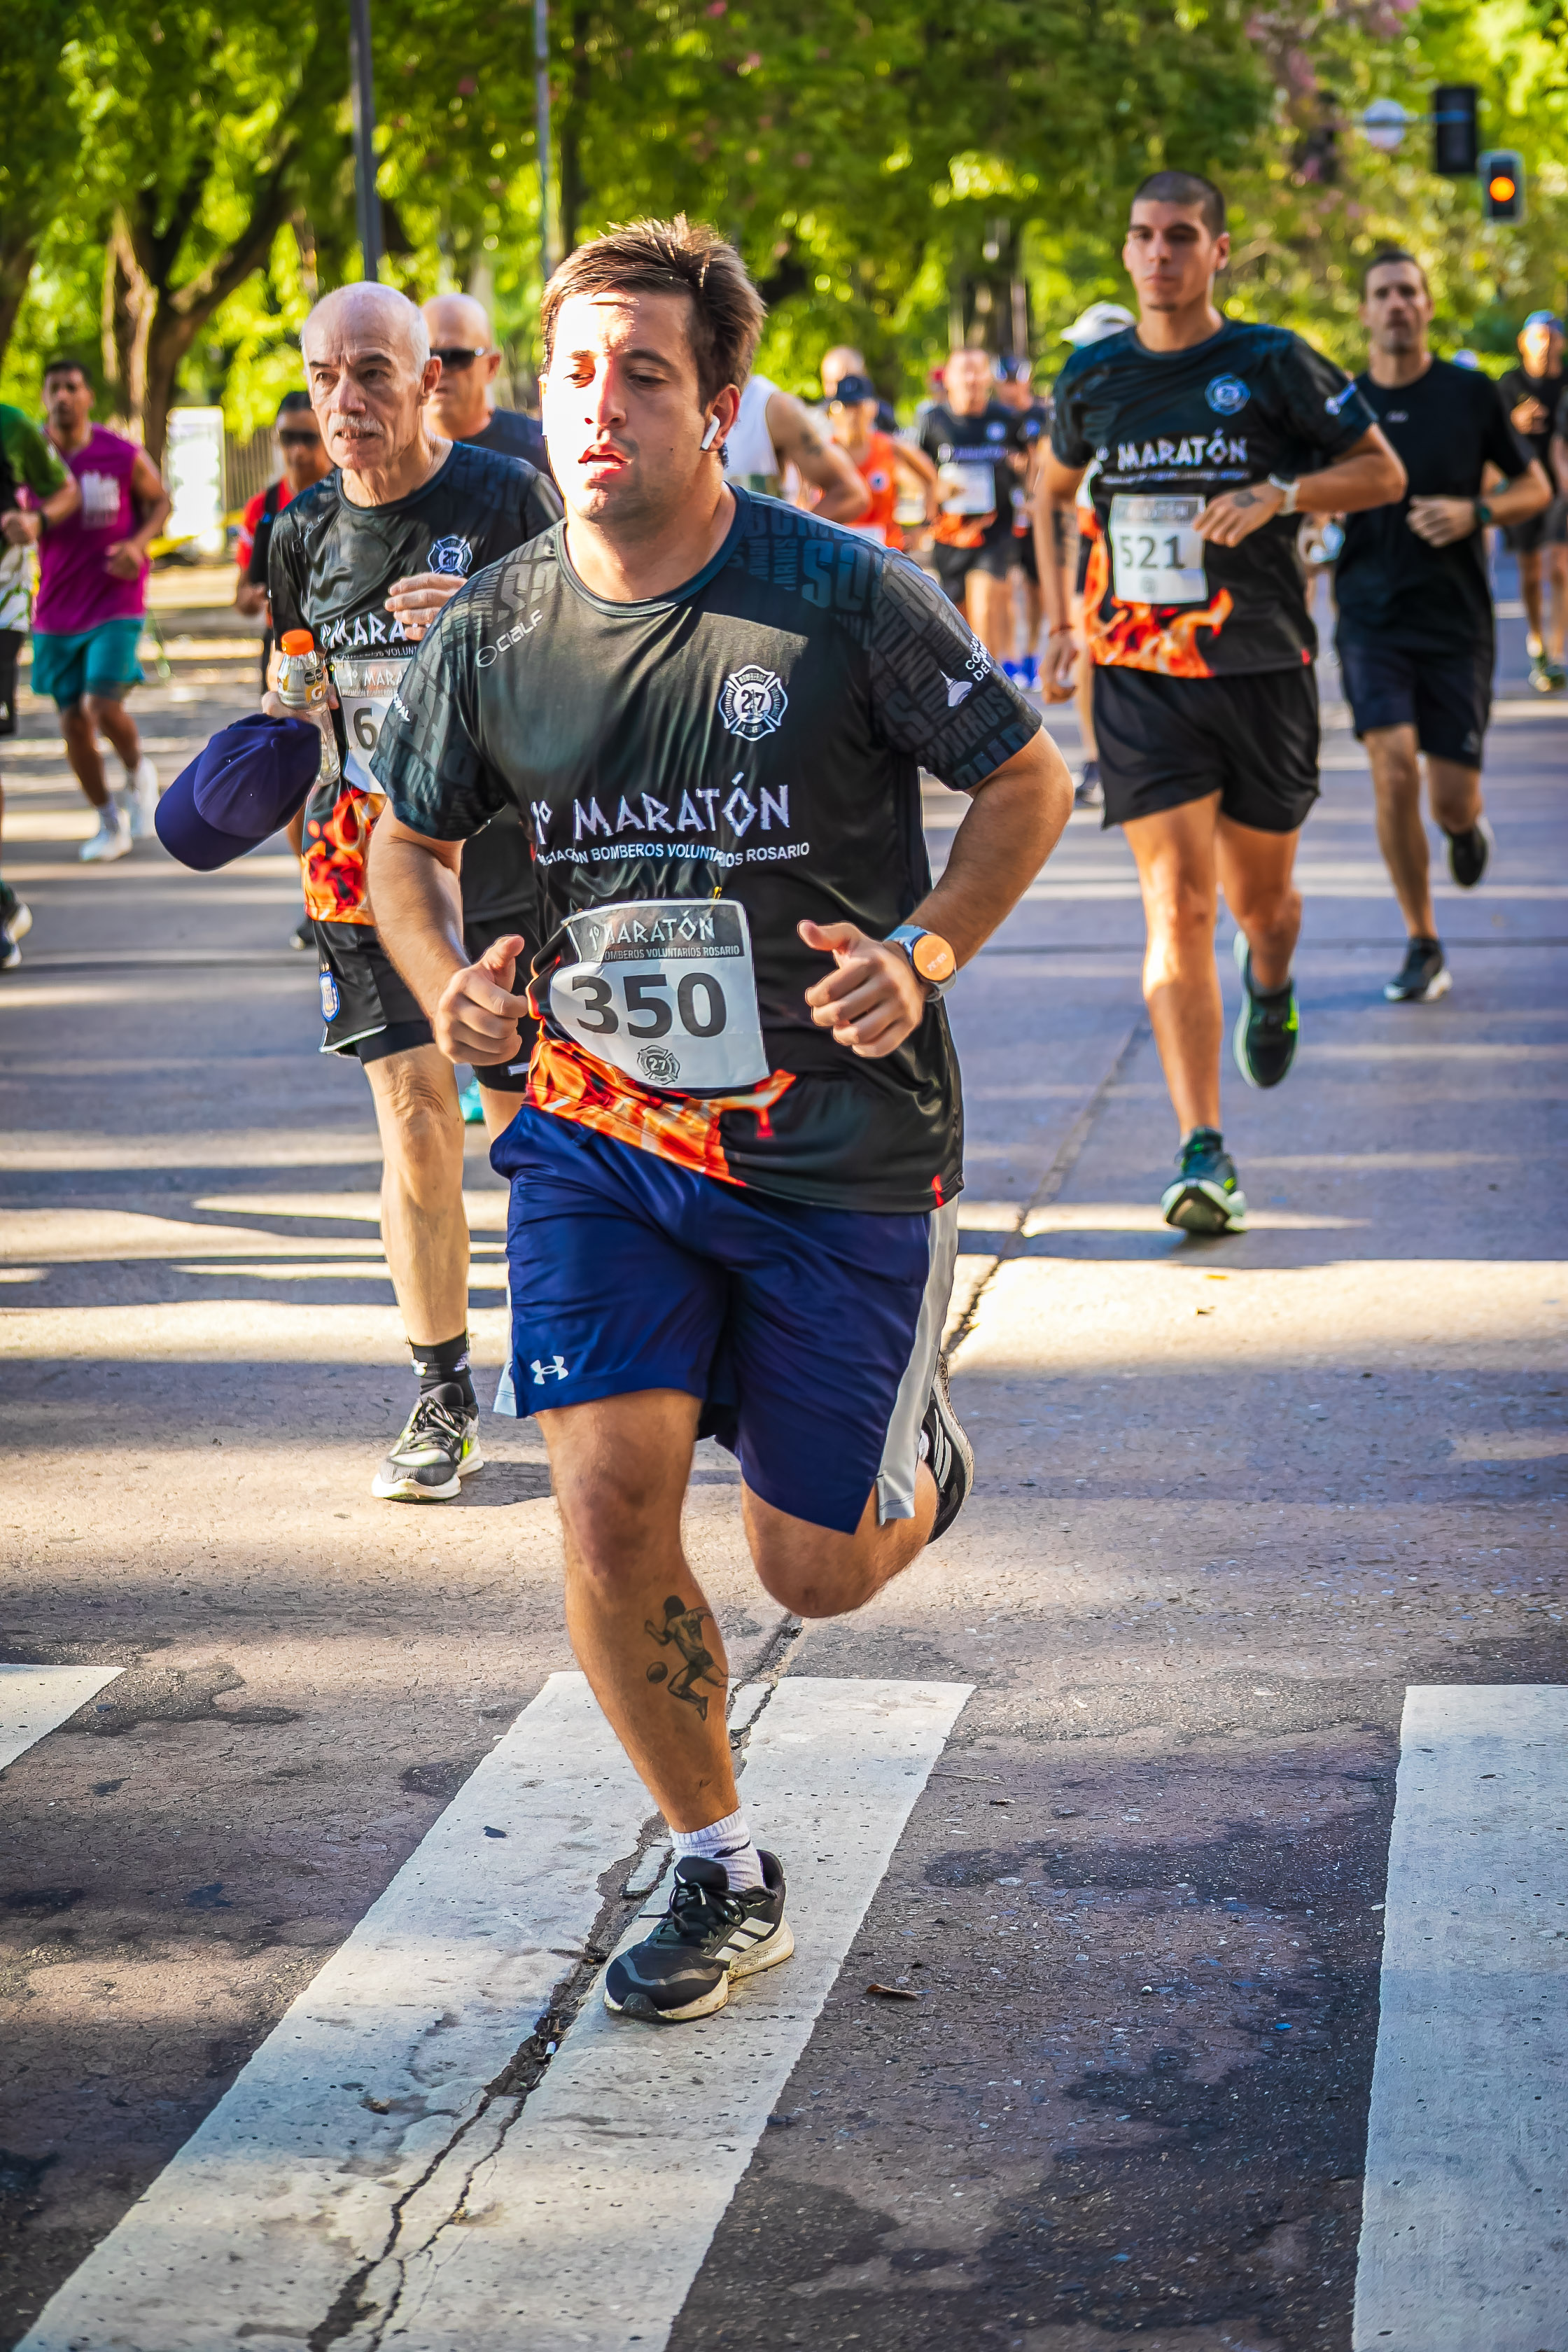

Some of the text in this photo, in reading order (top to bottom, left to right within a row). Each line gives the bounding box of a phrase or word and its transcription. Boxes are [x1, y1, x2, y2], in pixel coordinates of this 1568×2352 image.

[1118, 427, 1248, 472] MARATÓN
[1120, 534, 1186, 569] 521
[329, 611, 432, 650] MARA
[741, 689, 766, 713] 27
[573, 771, 790, 841] MARATÓN
[592, 843, 664, 862] BOMBEROS
[746, 841, 811, 862] ROSARIO
[604, 910, 715, 945] MARATÓN
[604, 944, 741, 962] OMBEROS VOLUNTARIOS ROSARIO
[572, 972, 727, 1039] 350
[649, 1057, 666, 1072] 27
